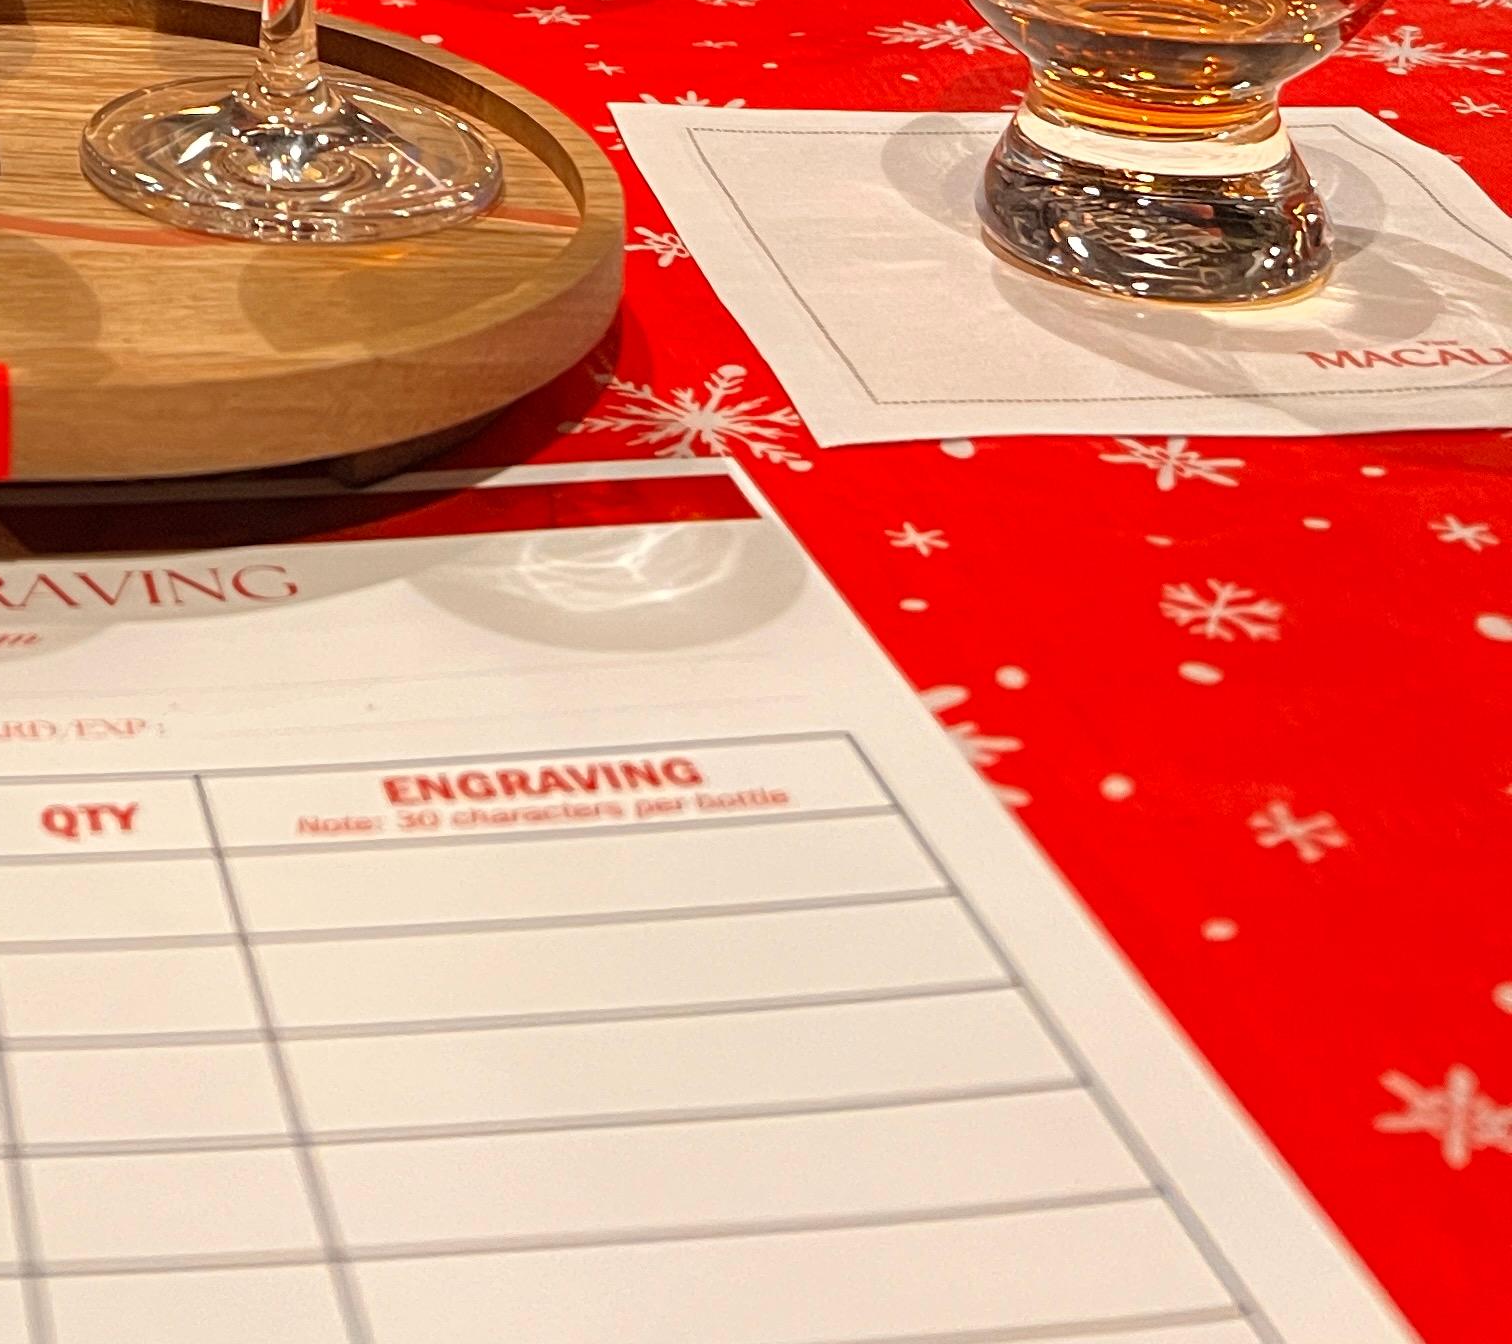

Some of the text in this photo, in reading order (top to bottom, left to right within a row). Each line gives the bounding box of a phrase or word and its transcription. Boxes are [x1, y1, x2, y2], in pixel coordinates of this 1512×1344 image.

[381, 757, 705, 806] ENGRAVING
[40, 803, 140, 842] QTY
[296, 814, 381, 835] Note:
[451, 801, 624, 829] characters
[634, 797, 687, 821] per
[694, 787, 791, 812] bottle
